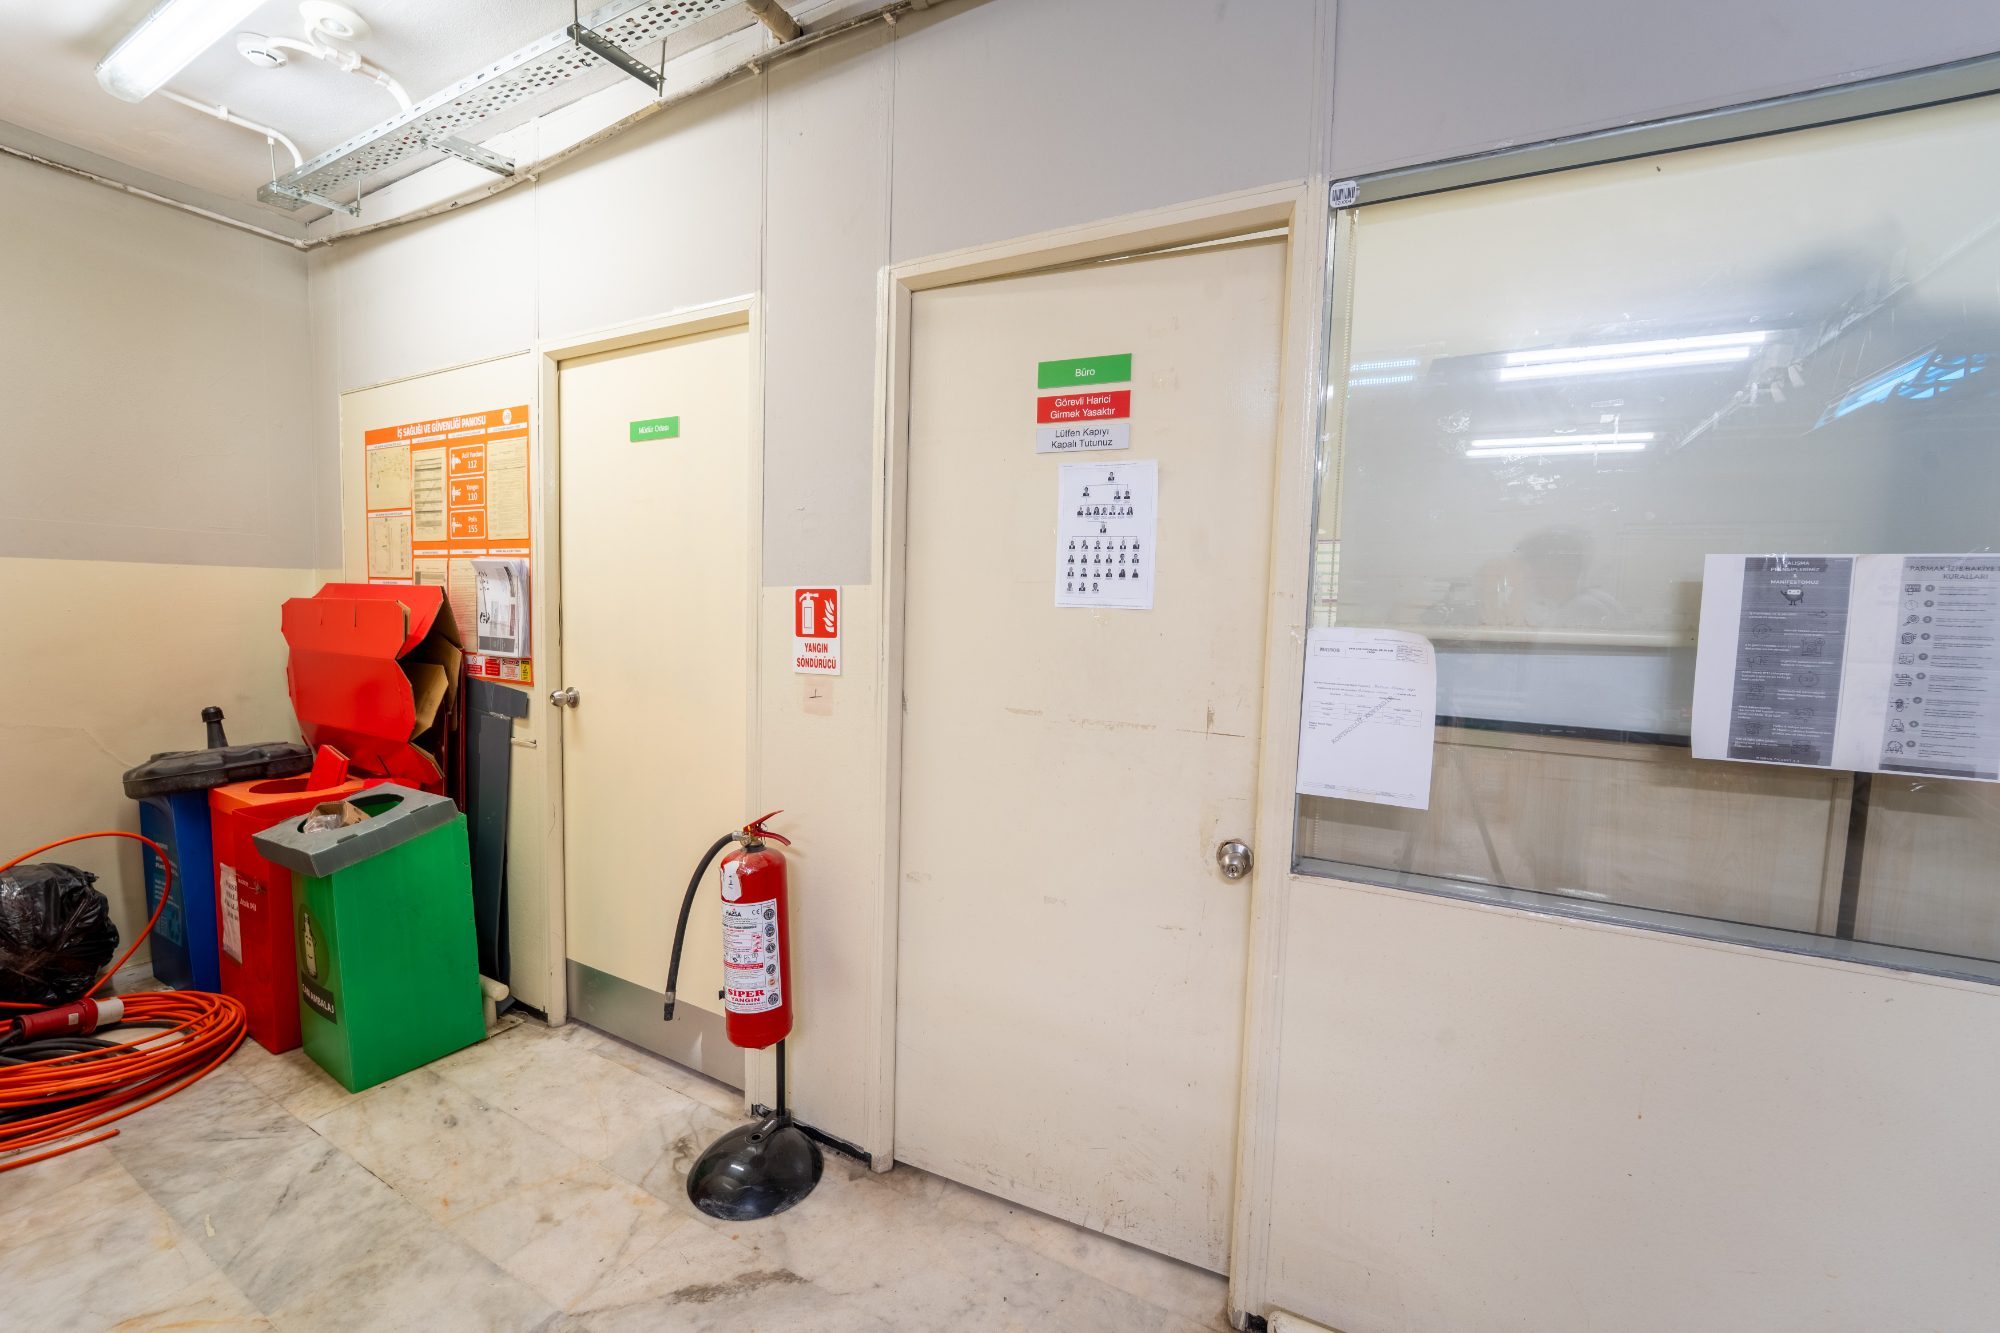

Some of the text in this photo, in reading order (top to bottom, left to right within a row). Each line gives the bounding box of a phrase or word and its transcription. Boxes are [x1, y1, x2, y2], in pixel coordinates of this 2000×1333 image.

[1075, 368, 1095, 377] Büro
[1055, 395, 1111, 407] Görevli Harici
[1050, 407, 1115, 419] Girmek Yasaktır
[403, 424, 423, 437] SAĞLIĞI
[423, 423, 430, 433] VE
[431, 418, 461, 432] GÜVENLİĞİ
[462, 416, 486, 427] PANOSU
[1056, 428, 1109, 437] Lütfen Kapıyı
[1051, 439, 1112, 449] Kapalı Tutunuz
[467, 460, 477, 468] 112
[468, 524, 478, 532] 155
[804, 642, 828, 653] YANGIN
[796, 655, 836, 669] SÖNDÜRÜCÜ
[728, 988, 765, 997] SİPER
